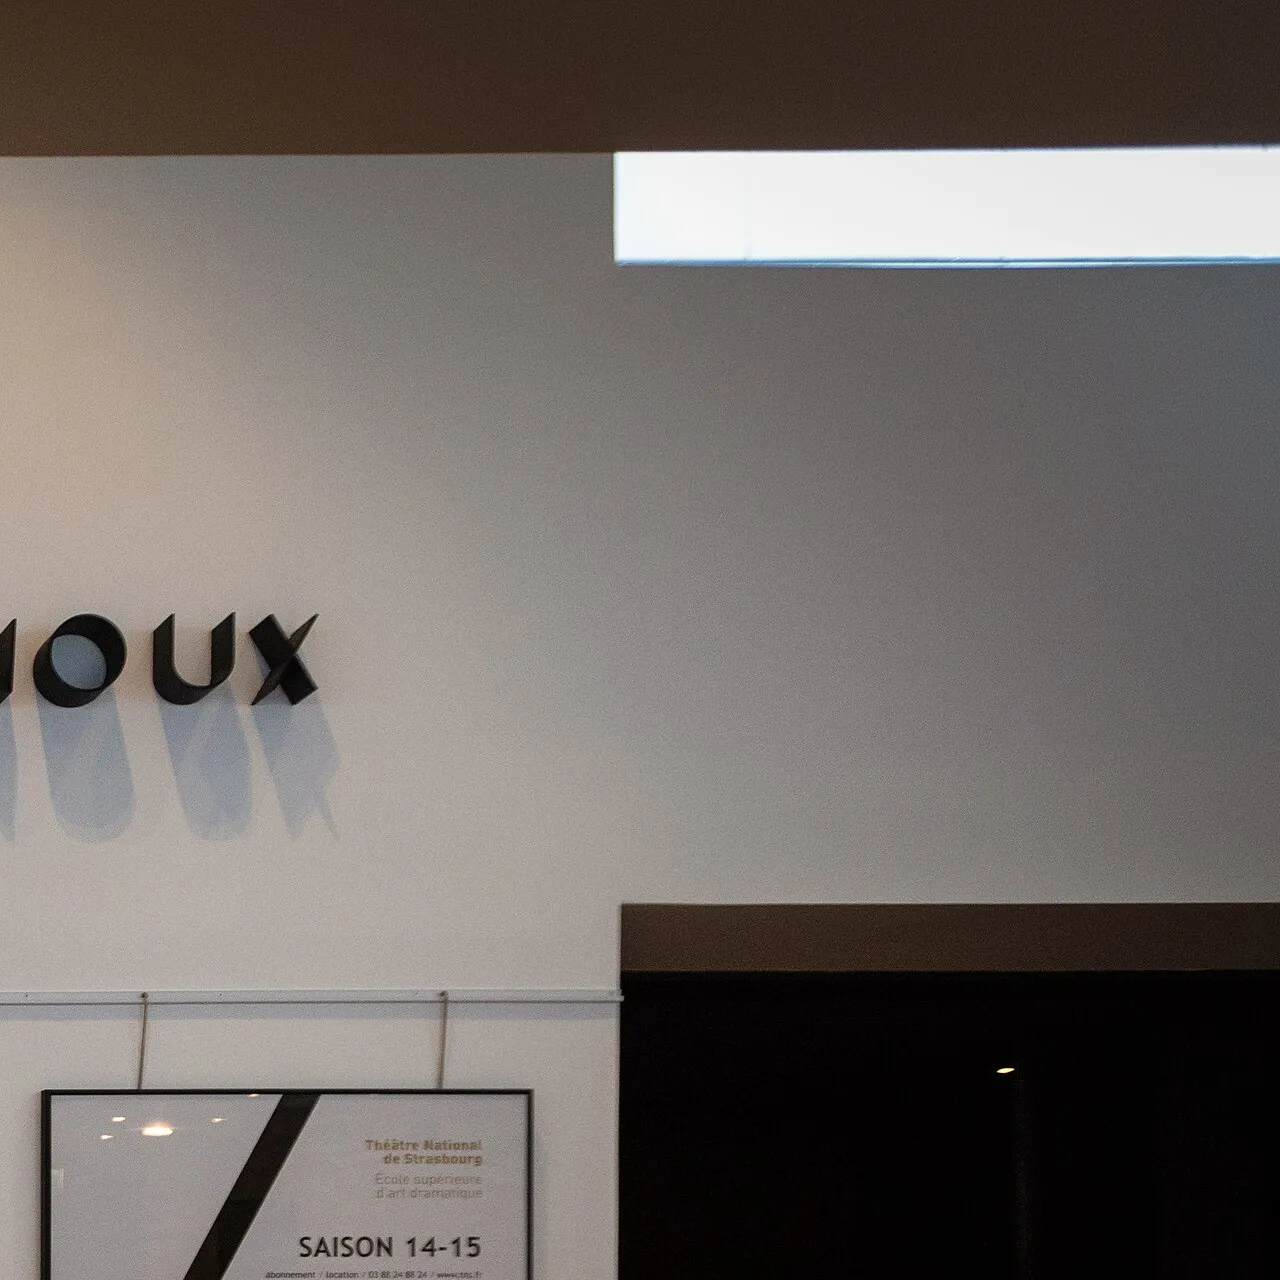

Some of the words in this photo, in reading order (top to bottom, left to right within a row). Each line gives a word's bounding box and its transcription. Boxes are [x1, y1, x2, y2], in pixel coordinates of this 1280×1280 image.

[365, 1138, 420, 1151] Théâtre
[423, 1139, 483, 1151] National
[383, 1153, 401, 1164] de
[404, 1153, 483, 1167] Strasbourg
[410, 1187, 483, 1199] dramatique
[298, 1236, 394, 1258] SAISON
[406, 1236, 482, 1258] 14-15
[265, 1271, 316, 1279] abonnement
[325, 1271, 359, 1279] location
[368, 1271, 379, 1279] 03
